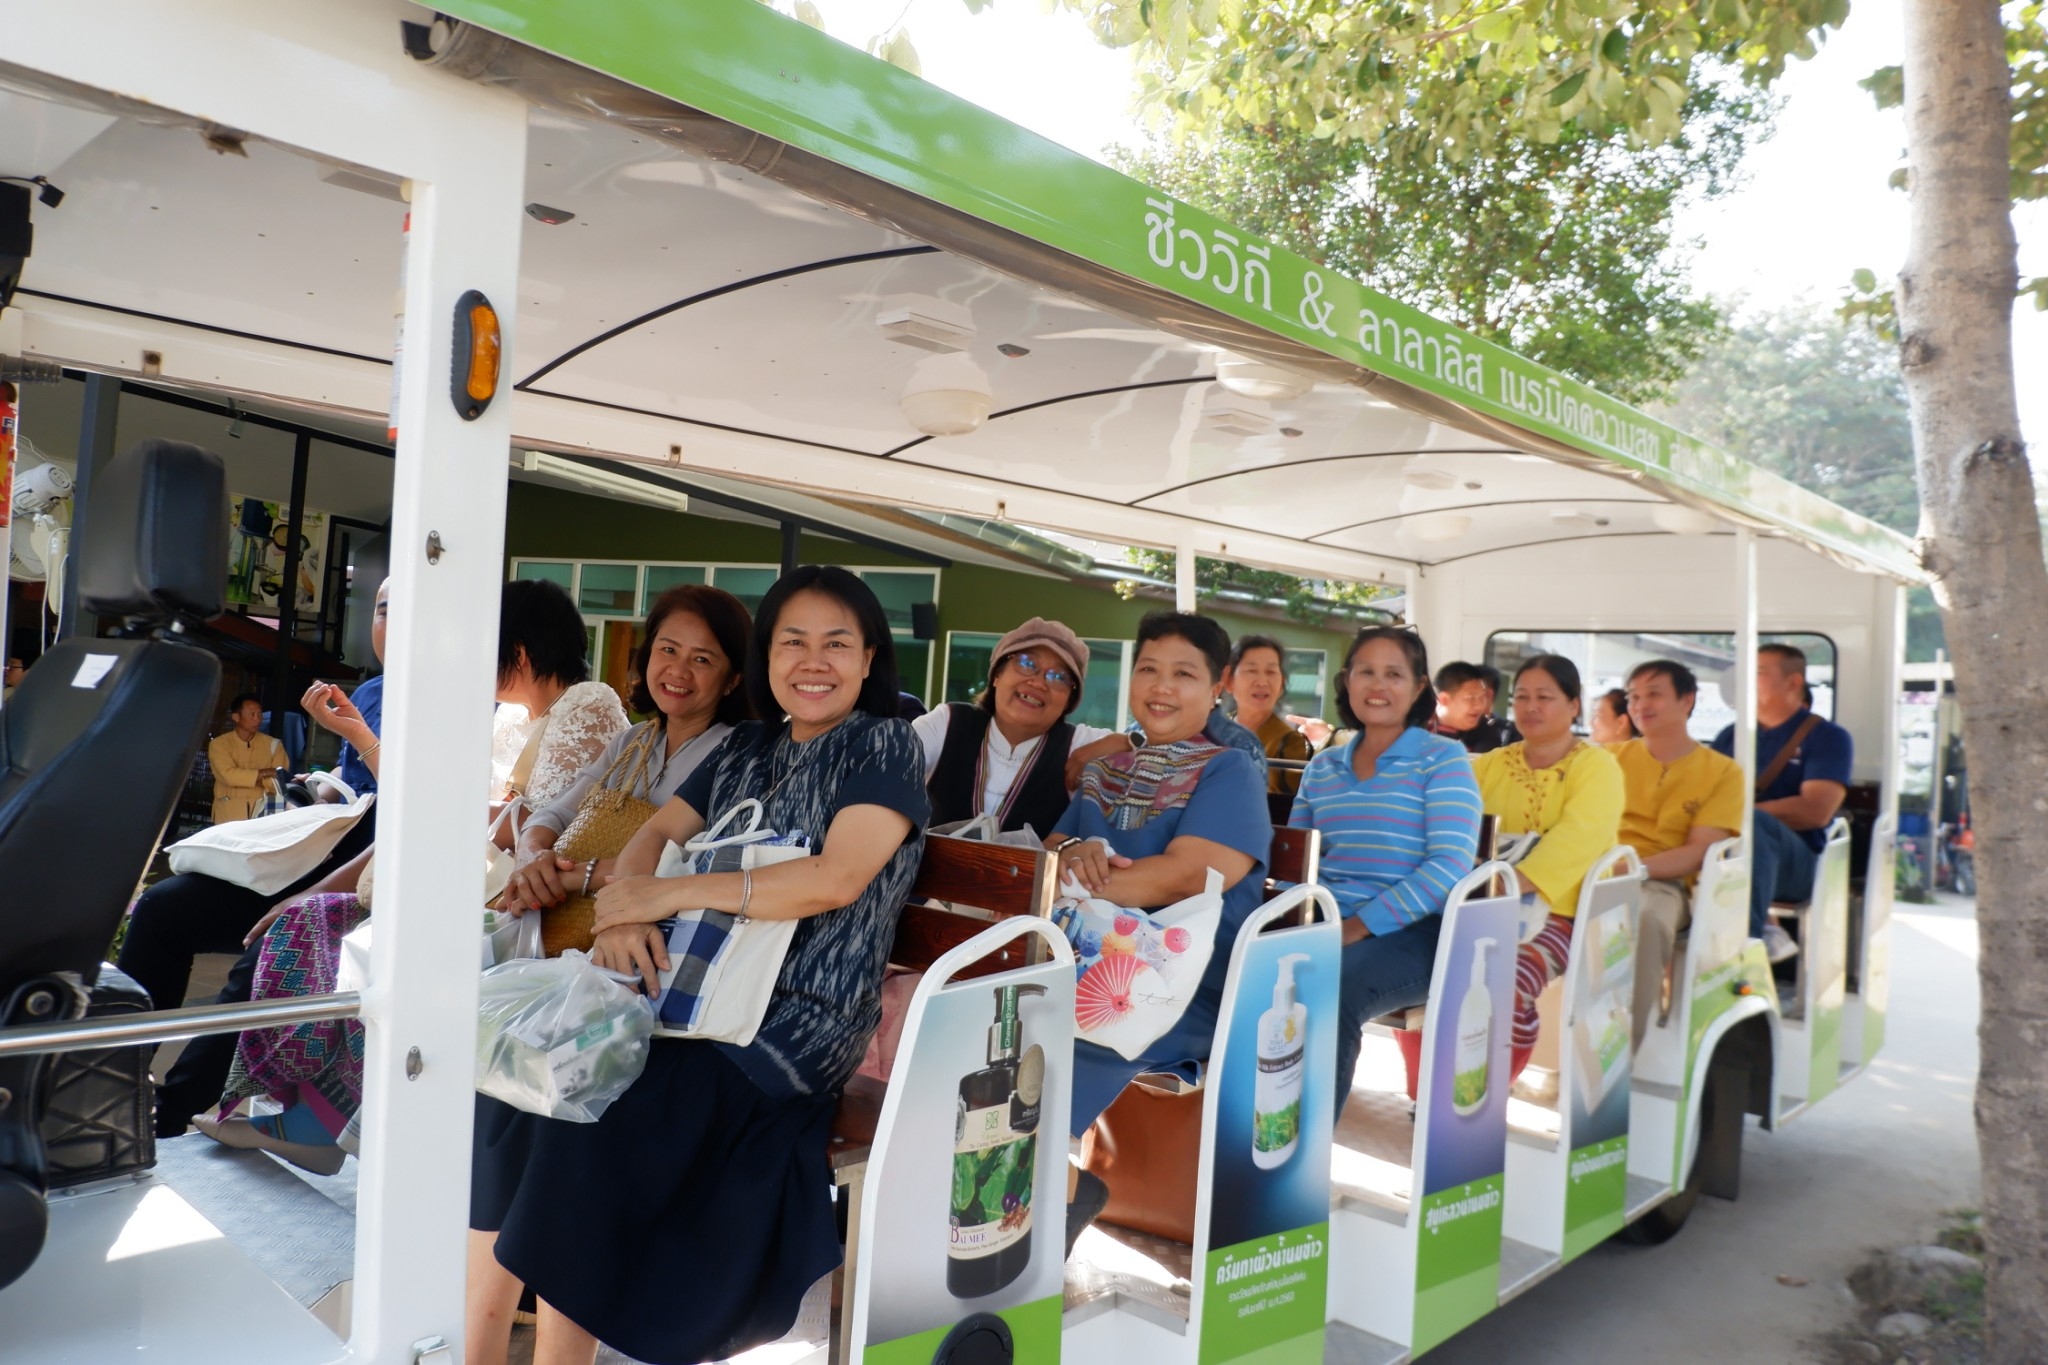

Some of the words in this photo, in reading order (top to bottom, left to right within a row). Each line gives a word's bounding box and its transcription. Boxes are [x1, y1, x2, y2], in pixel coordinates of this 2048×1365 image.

[1144, 197, 1272, 312] ชีววิถี
[1299, 271, 1337, 338] &
[1358, 308, 1485, 394] ลาลาลิส
[1500, 367, 1660, 471] เนรมิตความสุข
[1216, 1234, 1323, 1286] ครีมทาผิวน้ำนมข้าว
